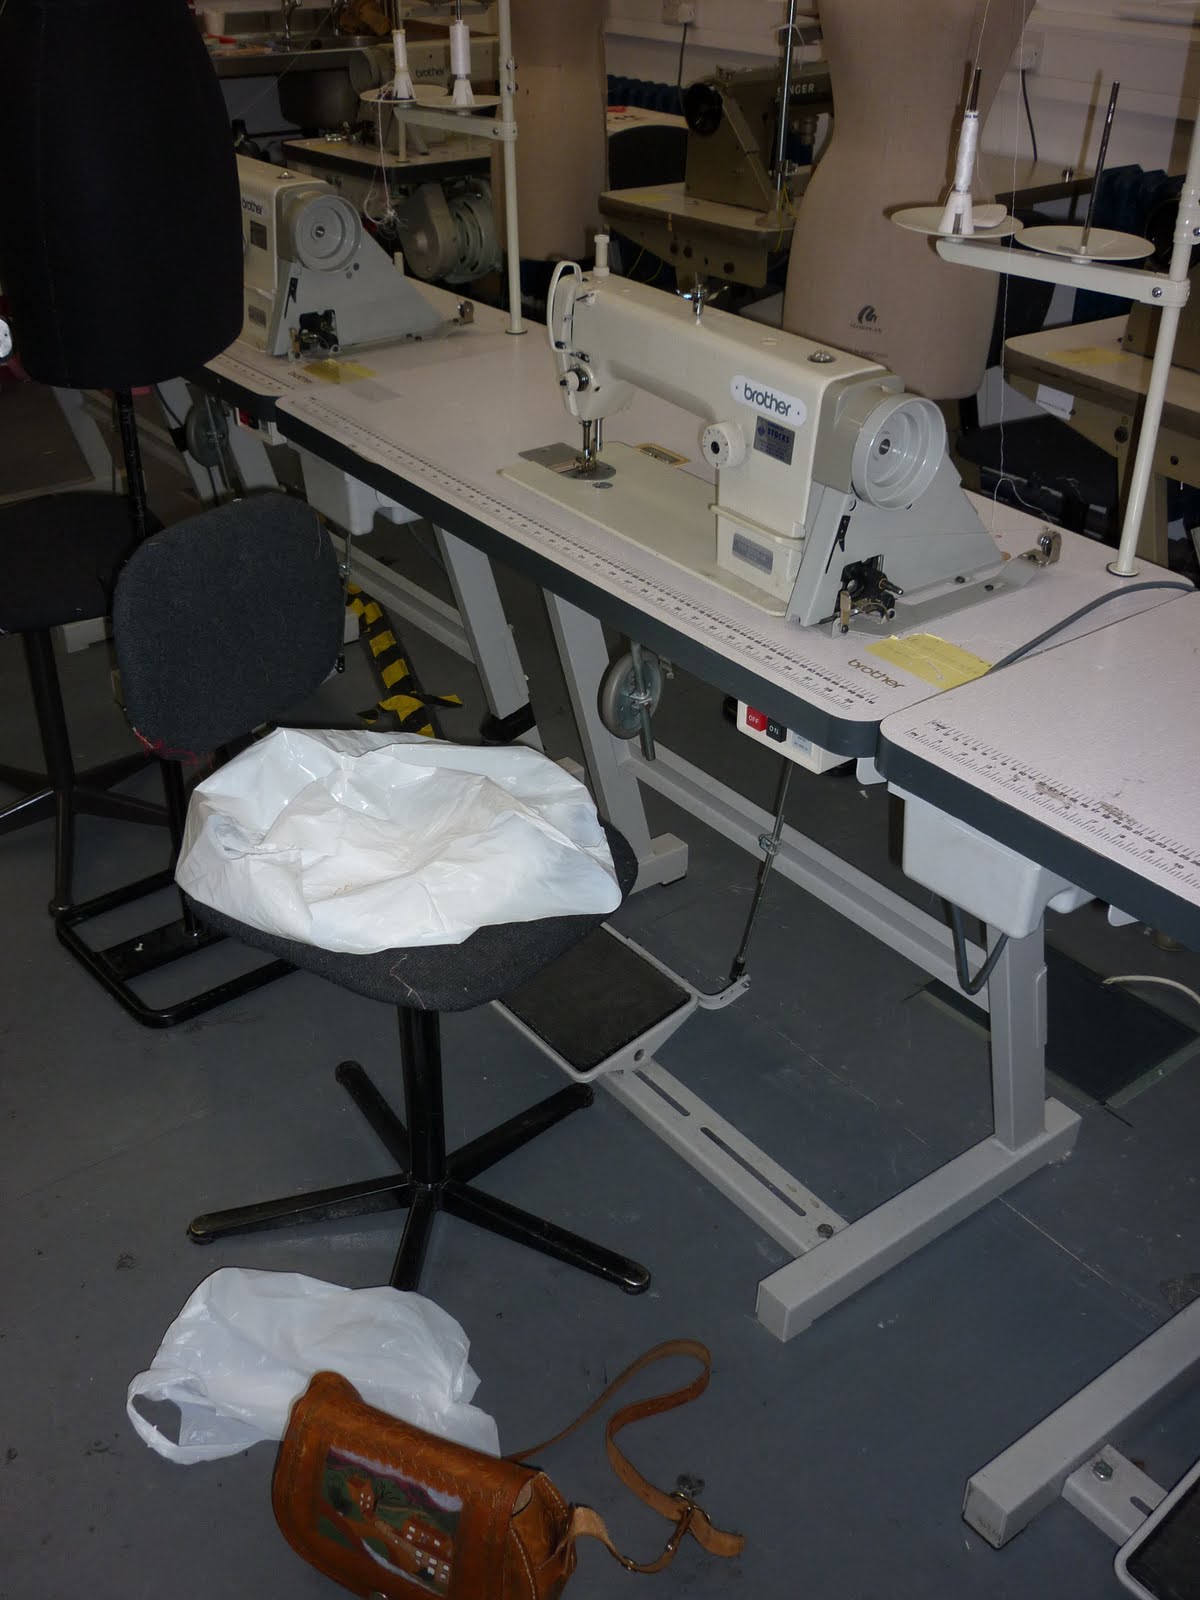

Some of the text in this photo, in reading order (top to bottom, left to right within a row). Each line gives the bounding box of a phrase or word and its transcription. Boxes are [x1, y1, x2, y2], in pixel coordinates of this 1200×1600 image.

[777, 83, 814, 96] SNGER
[744, 383, 791, 416] brother
[768, 428, 790, 444] STOCKS
[848, 658, 904, 688] brother
[748, 715, 759, 724] OFF
[769, 725, 779, 735] ON
